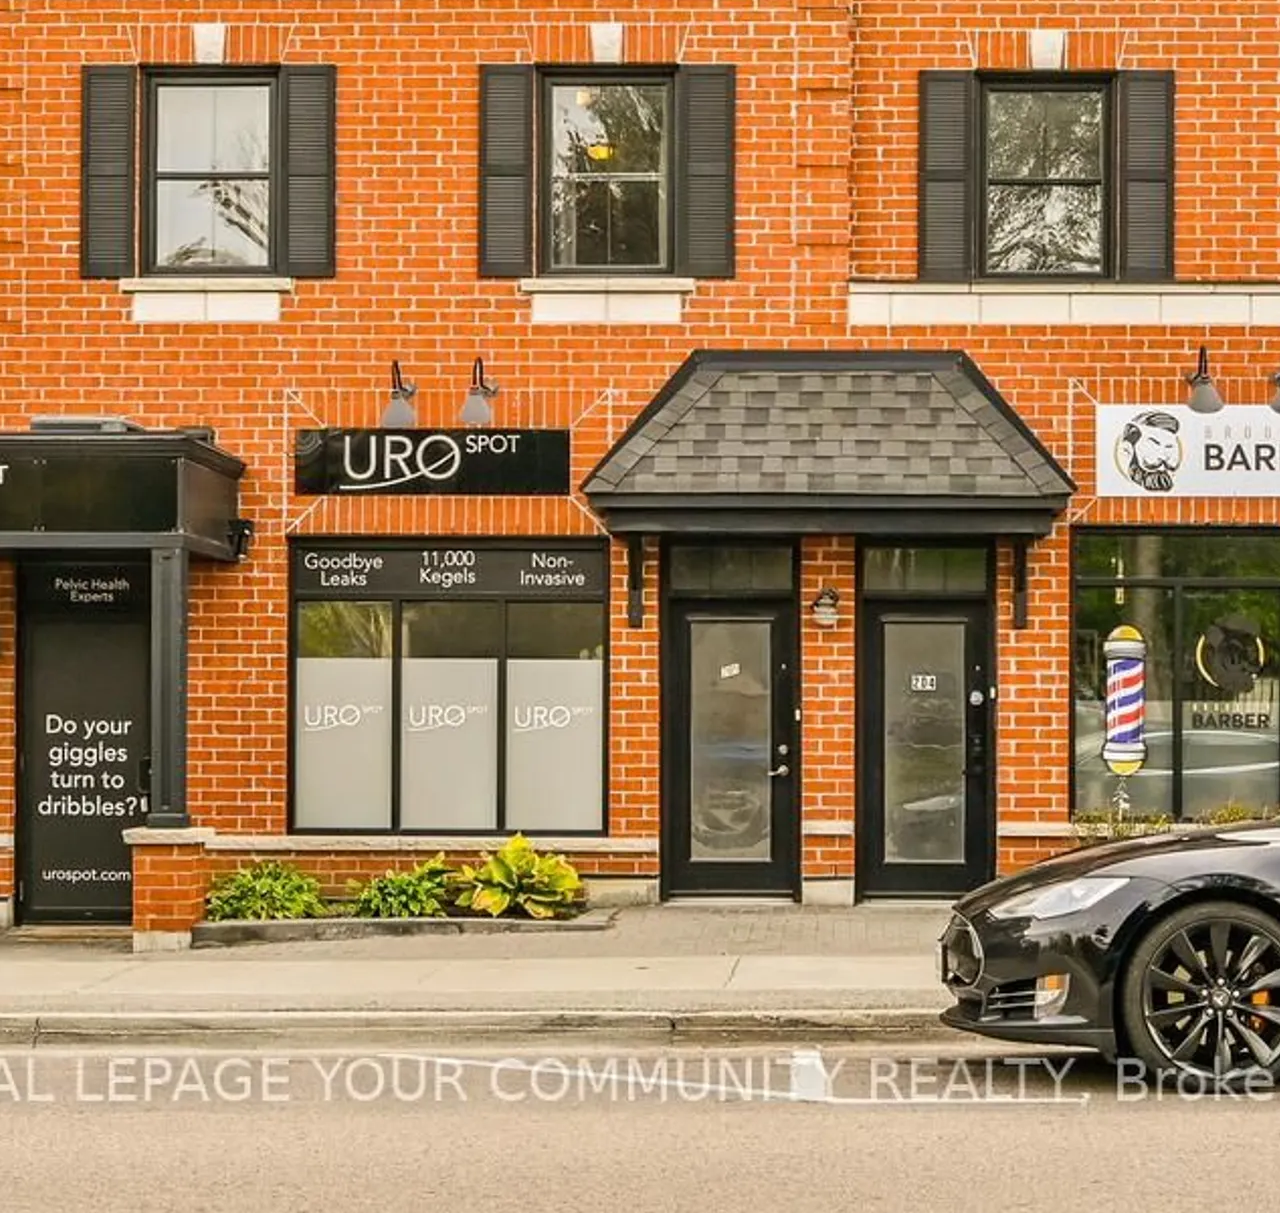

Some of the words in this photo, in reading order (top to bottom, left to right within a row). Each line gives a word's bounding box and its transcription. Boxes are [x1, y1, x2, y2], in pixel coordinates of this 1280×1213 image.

[344, 435, 461, 480] URO
[465, 435, 520, 454] SPOT
[304, 553, 383, 570] Goodbye
[421, 551, 476, 567] 11,000
[532, 553, 574, 568] Non-
[54, 577, 89, 590] Pelvic
[90, 577, 130, 590] Health
[320, 571, 367, 587] Leaks
[419, 568, 476, 587] Kegels
[520, 570, 586, 586] Invasive
[70, 591, 114, 602] Experts
[912, 676, 936, 690] 204
[304, 704, 361, 726] URO
[409, 704, 466, 727] URO
[514, 705, 570, 728] URO
[1192, 713, 1270, 728] BARBER
[45, 714, 77, 734] Do
[83, 720, 132, 740] your
[49, 741, 128, 767] giggles
[50, 771, 95, 789] turn
[101, 771, 125, 789] to
[38, 794, 138, 816] dribbles?
[42, 868, 132, 883] urospot.com
